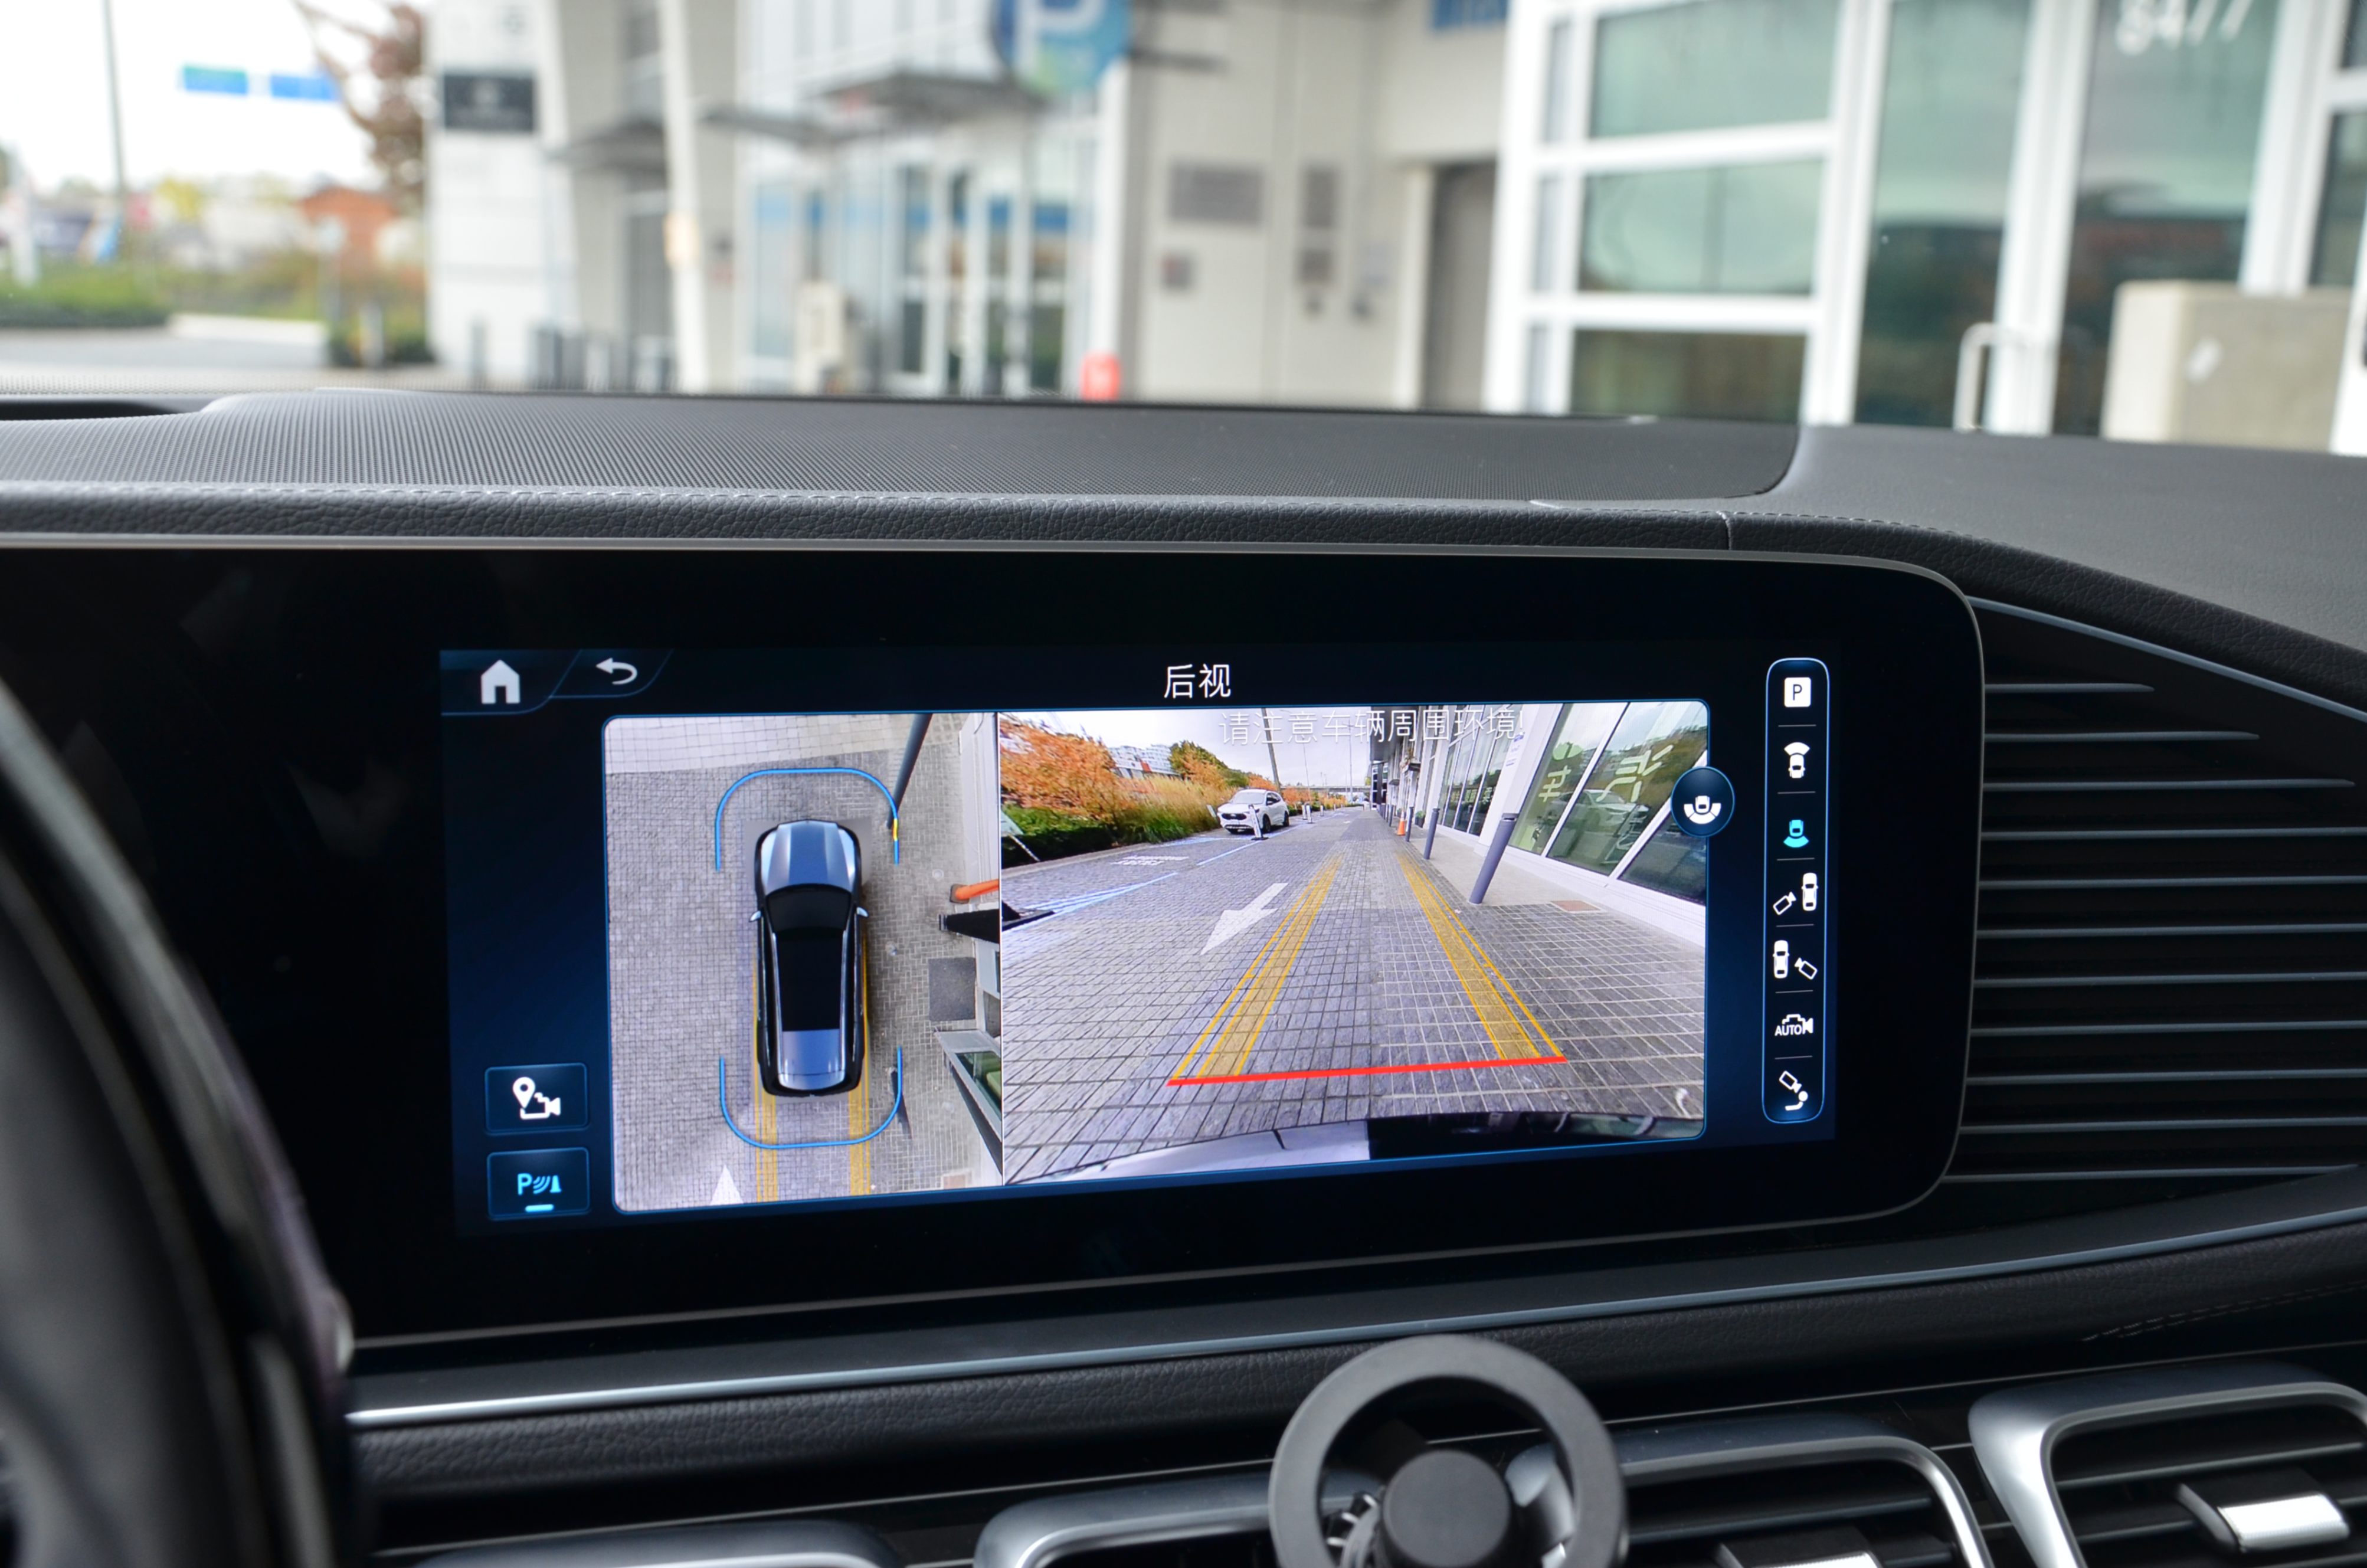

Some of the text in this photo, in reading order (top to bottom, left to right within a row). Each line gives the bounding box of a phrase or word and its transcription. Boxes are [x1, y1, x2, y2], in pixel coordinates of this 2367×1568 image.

[1164, 663, 1231, 699] 后视
[1792, 683, 1803, 701] P
[1775, 1024, 1802, 1036] AUTO
[518, 1173, 532, 1196] P
